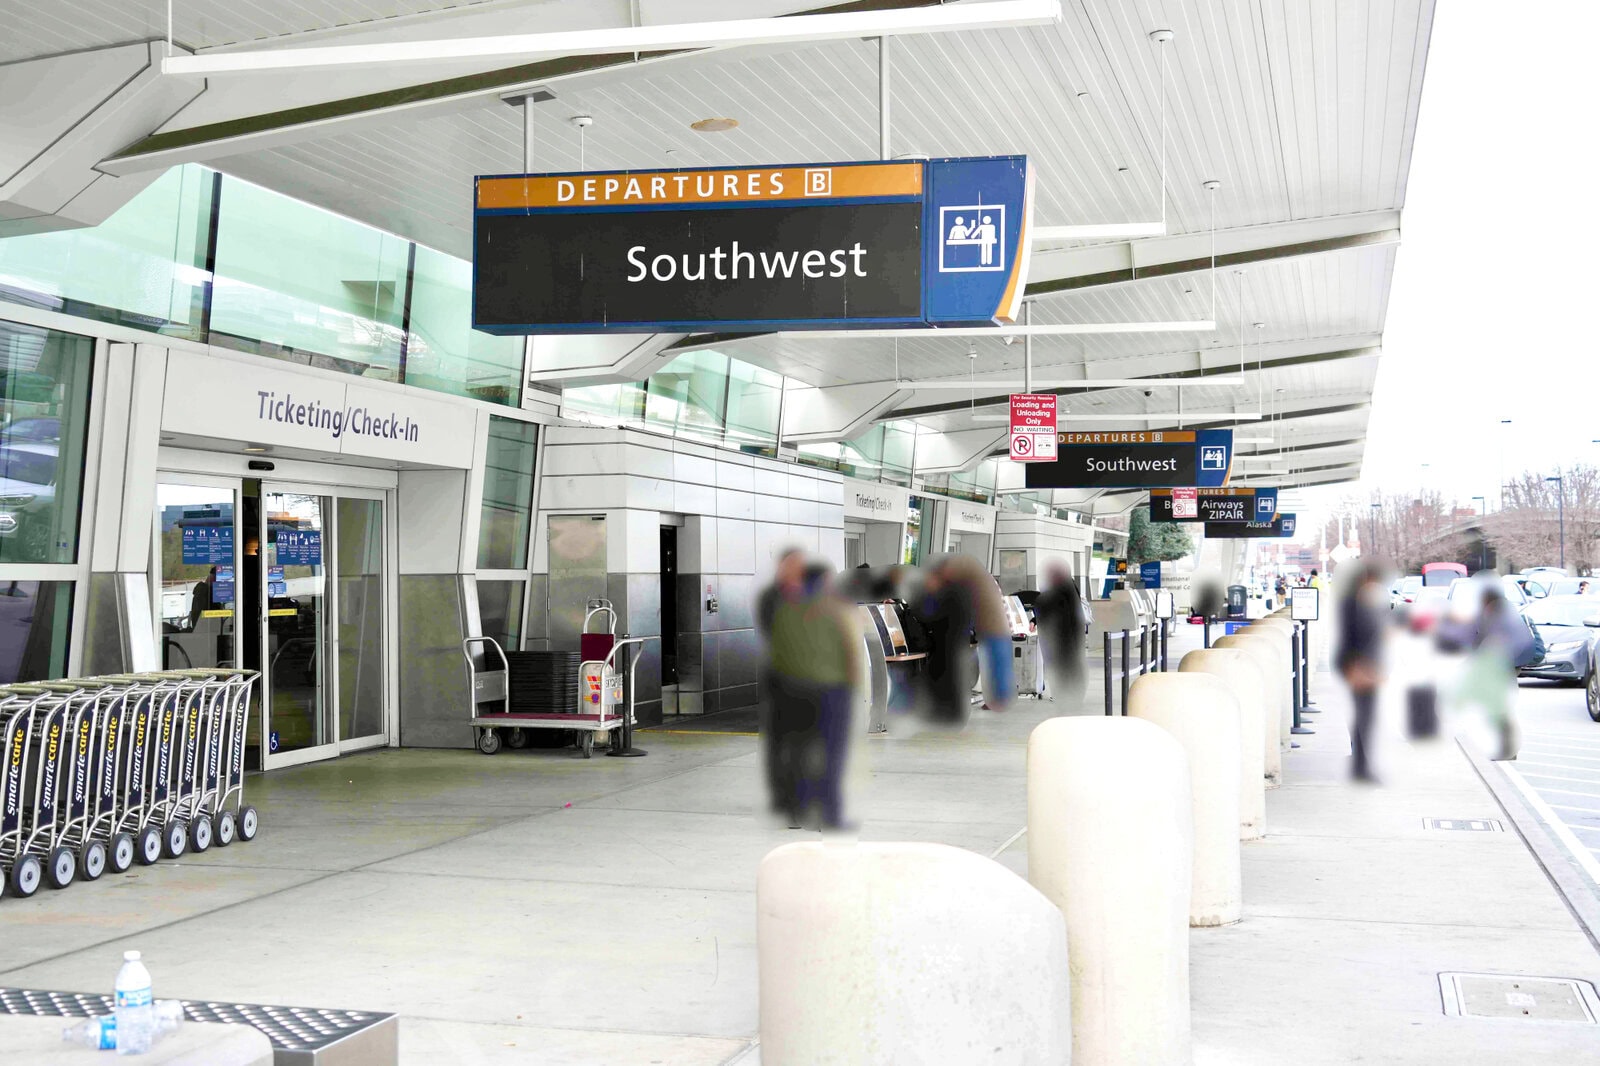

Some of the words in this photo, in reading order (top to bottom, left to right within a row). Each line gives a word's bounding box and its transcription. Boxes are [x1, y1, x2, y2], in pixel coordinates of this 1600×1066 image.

[557, 172, 784, 202] DEPARTURES
[627, 241, 868, 283] Southwest
[257, 390, 419, 442] Ticketing/Check-In
[1012, 401, 1039, 409] Loading
[1042, 401, 1055, 409] and
[1016, 409, 1050, 418] Unloading
[1025, 417, 1041, 425] Only
[1058, 432, 1145, 443] DEPARTURES
[1086, 457, 1177, 472] Southwest
[1201, 500, 1244, 512] Airways
[1209, 510, 1244, 520] ZIPAIR
[74, 720, 90, 803] smartecarte
[104, 716, 118, 797] smartecarte
[132, 712, 147, 791] smartecarte
[158, 709, 173, 787] smartecarte
[184, 707, 198, 782] smartecarte
[209, 704, 222, 778] smartecarte
[232, 702, 245, 774] smartecarte
[7, 728, 24, 816] smartecarte
[43, 724, 60, 809] smartecarte
